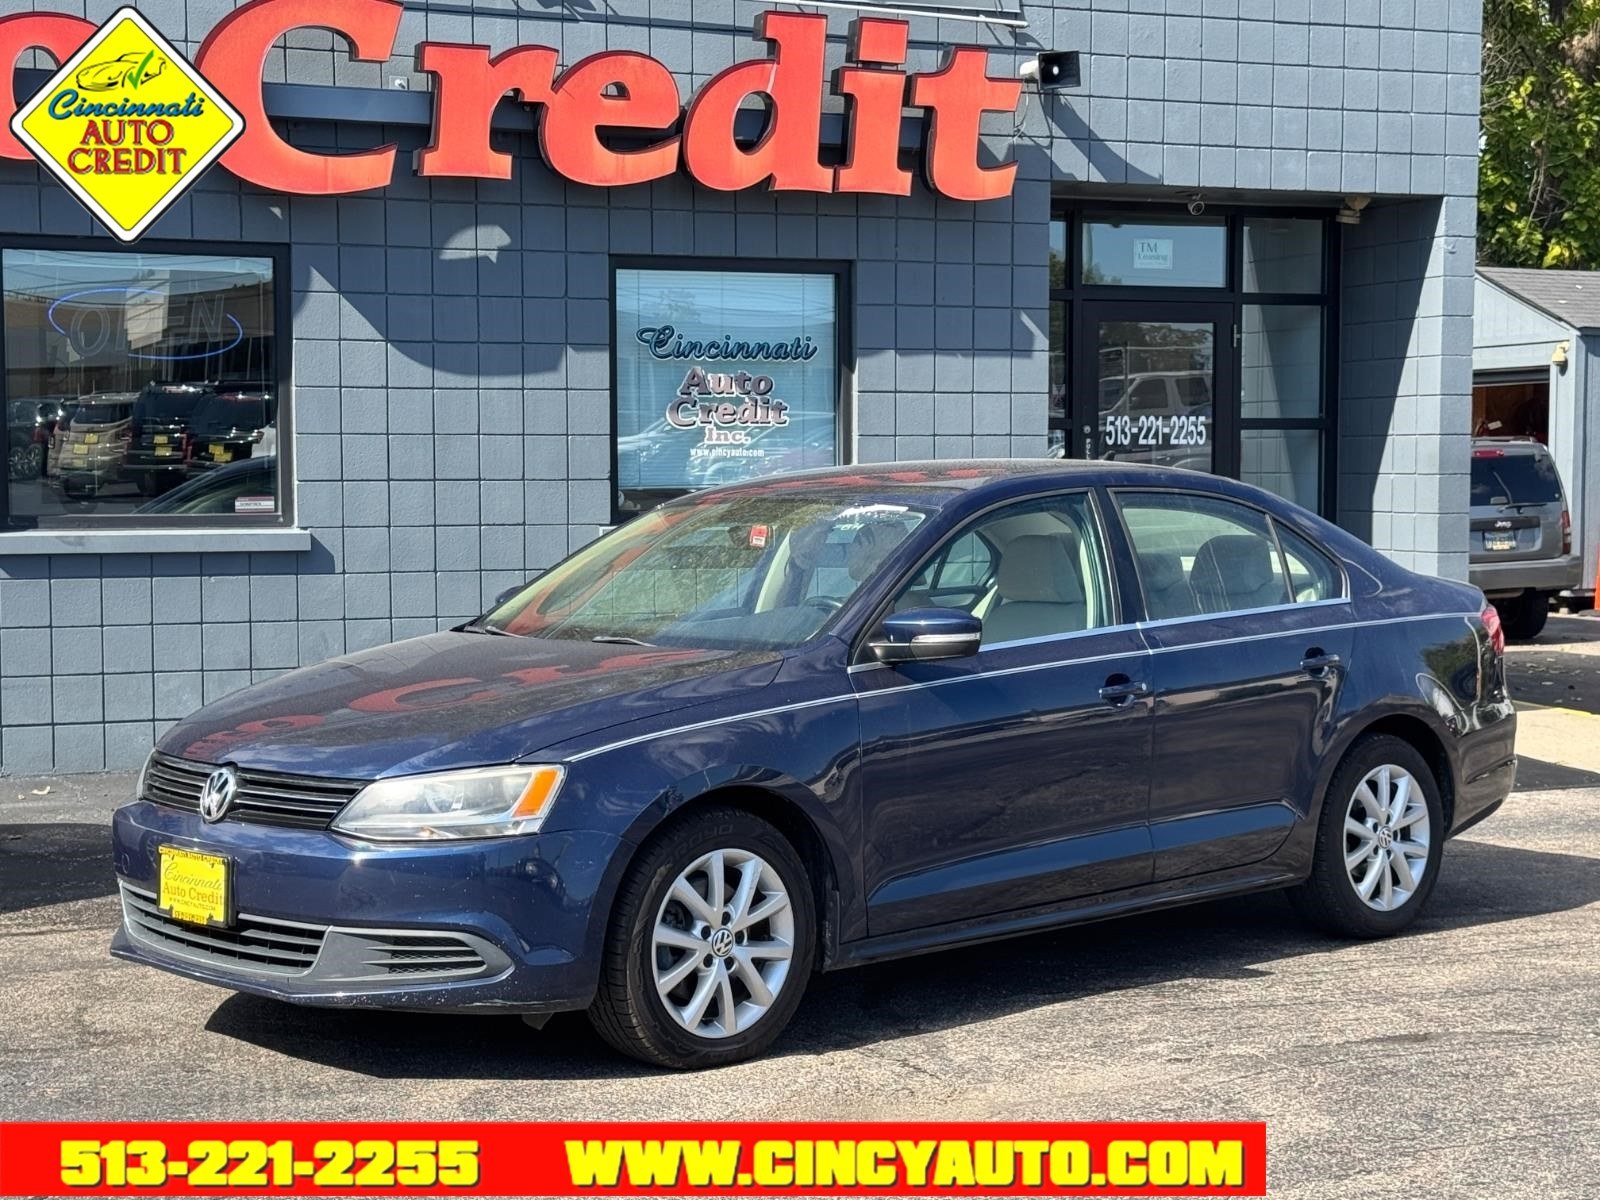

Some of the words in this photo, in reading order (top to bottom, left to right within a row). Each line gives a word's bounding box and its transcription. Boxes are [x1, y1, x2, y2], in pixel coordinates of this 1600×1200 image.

[195, 0, 1023, 200] Credit
[636, 325, 818, 361] Cincinnati
[678, 366, 774, 396] Auto
[666, 397, 790, 429] Credit
[704, 427, 751, 444] Inc.
[1106, 415, 1206, 445] 513-221-2255
[162, 881, 186, 898] Auto
[188, 887, 223, 905] Credit
